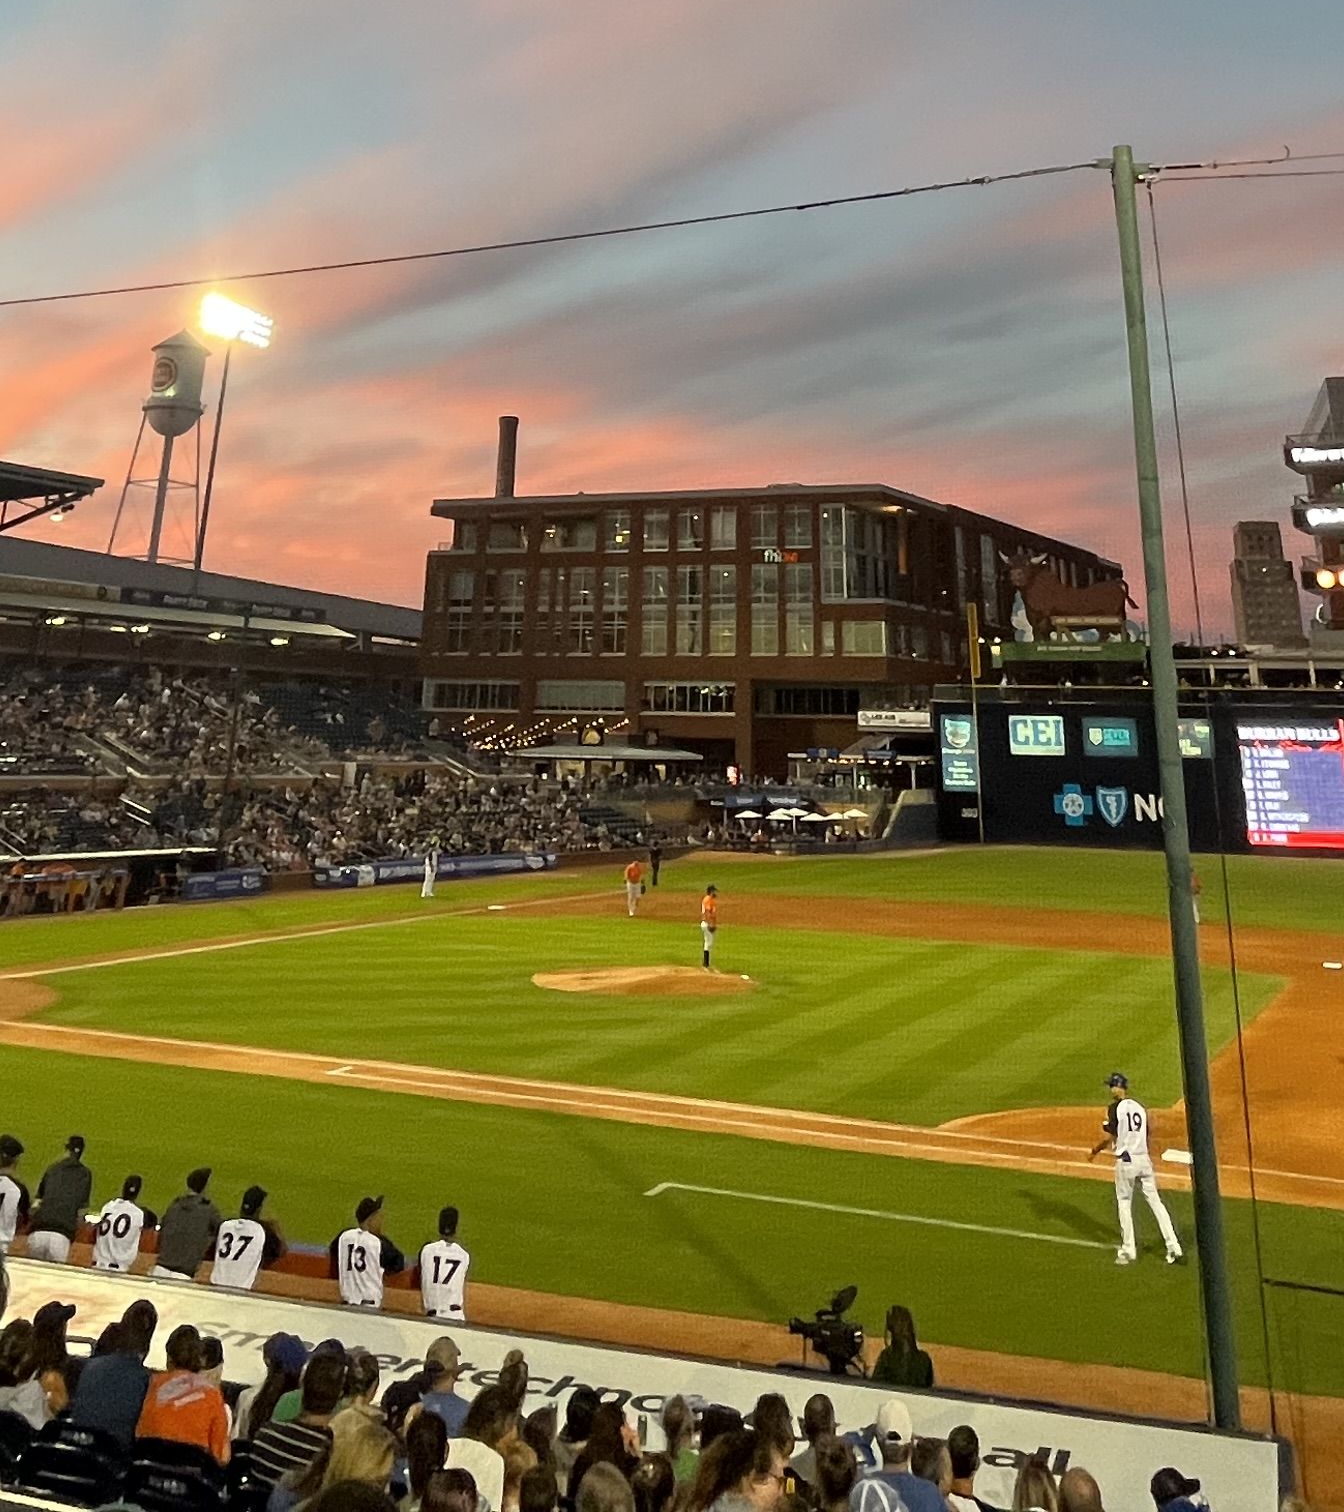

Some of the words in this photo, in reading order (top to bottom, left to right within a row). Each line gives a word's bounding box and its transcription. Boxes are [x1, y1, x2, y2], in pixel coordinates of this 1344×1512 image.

[1133, 793, 1164, 822] N
[1126, 1111, 1143, 1133] 19
[218, 1232, 254, 1261] 37
[346, 1243, 367, 1273] 13
[432, 1255, 461, 1285] 17
